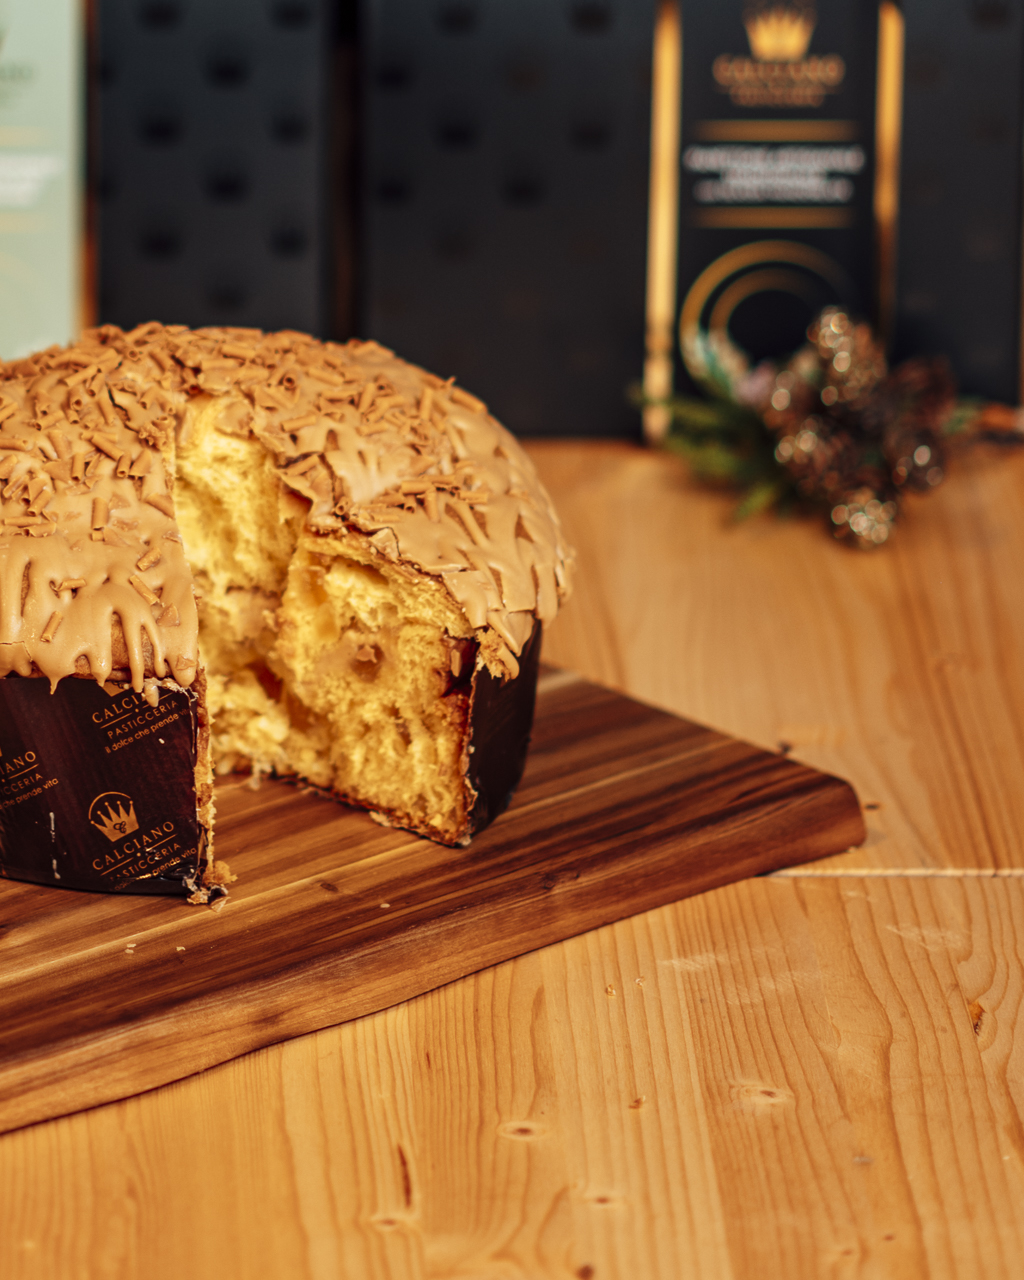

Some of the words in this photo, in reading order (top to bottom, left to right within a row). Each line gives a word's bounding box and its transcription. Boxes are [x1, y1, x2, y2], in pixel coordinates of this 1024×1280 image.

[92, 694, 143, 724] CALCI
[107, 700, 179, 740] PASTICCERIA
[111, 737, 134, 752] dolce
[134, 728, 150, 740] che
[150, 713, 179, 733] prende
[16, 787, 43, 804] prende
[42, 778, 59, 789] vita
[92, 821, 174, 870] CALCIANO
[181, 847, 197, 859] vita
